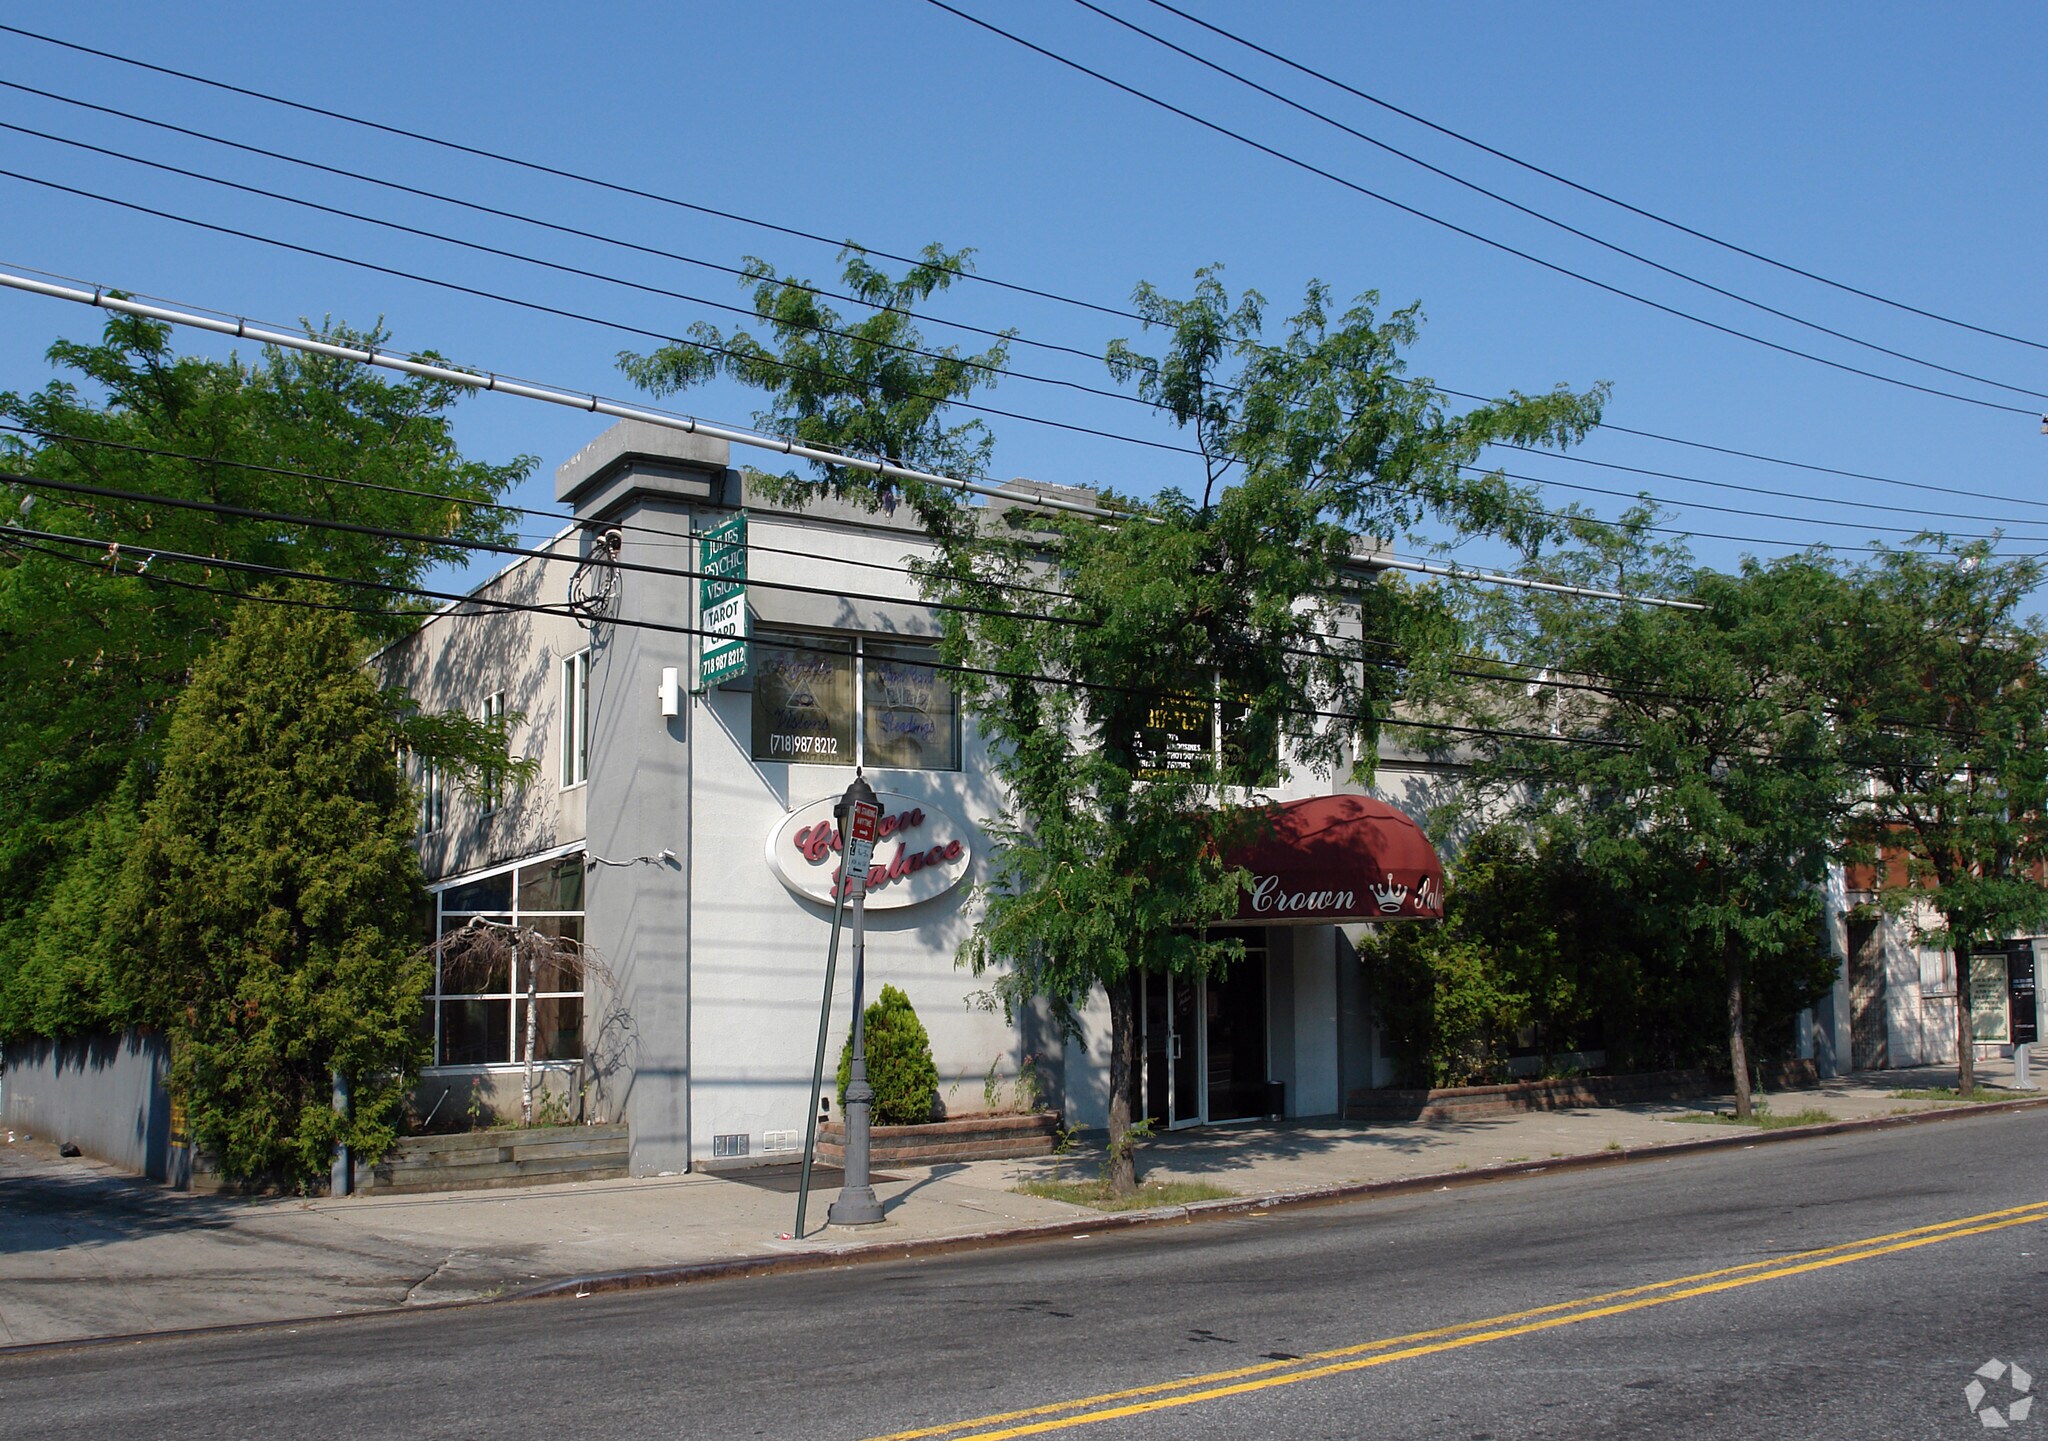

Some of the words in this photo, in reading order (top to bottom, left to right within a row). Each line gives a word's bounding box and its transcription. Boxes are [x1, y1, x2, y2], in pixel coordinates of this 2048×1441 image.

[704, 548, 744, 582] PSYCHIC
[709, 601, 739, 627] TAROT
[711, 622, 736, 645] CARD
[703, 657, 715, 676] 718
[715, 652, 728, 671] 987
[728, 646, 745, 667] 8212
[814, 736, 838, 755] 8212
[1251, 875, 1356, 912] Crown
